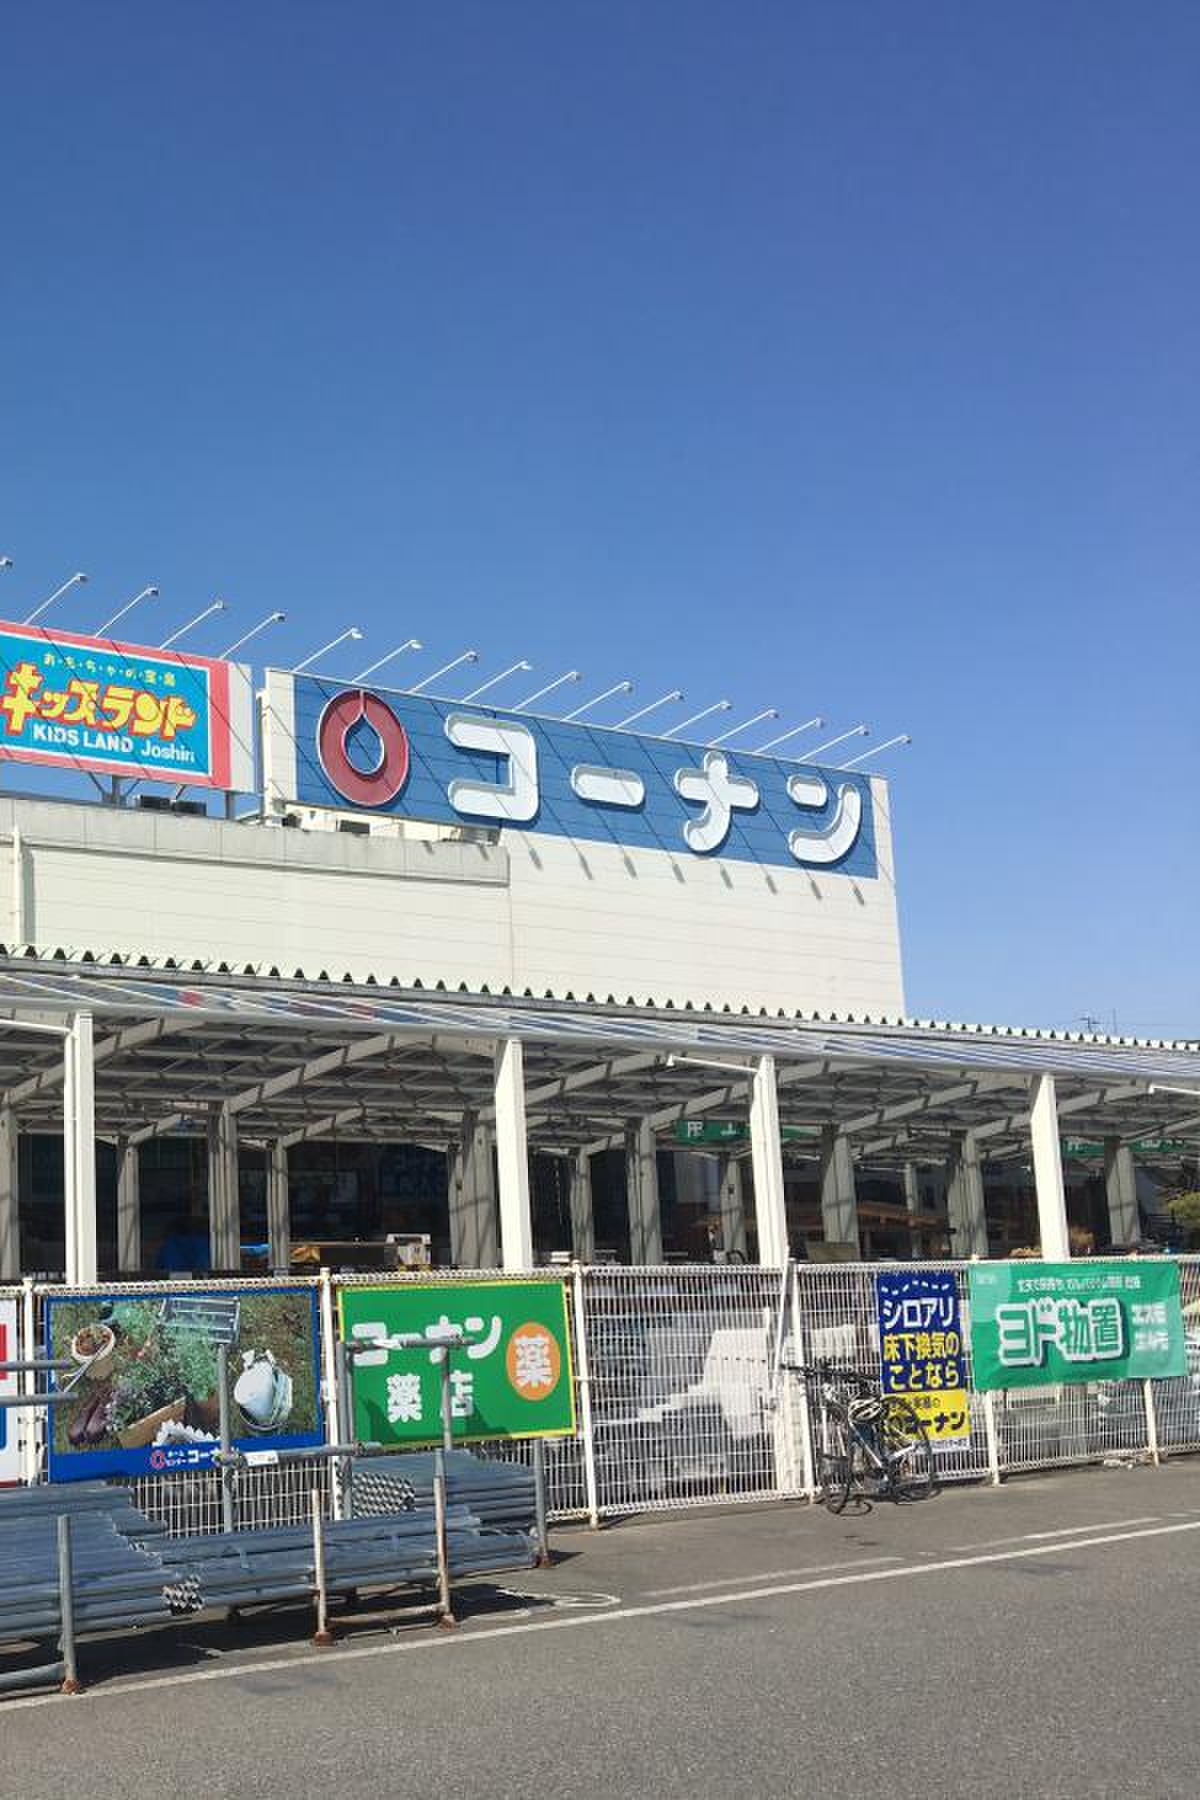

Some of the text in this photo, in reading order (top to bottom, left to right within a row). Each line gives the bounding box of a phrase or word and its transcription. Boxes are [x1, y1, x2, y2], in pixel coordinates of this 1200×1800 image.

[0, 662, 197, 739] キッズランド
[33, 724, 134, 754] KIDS LAND
[141, 740, 196, 764] Joshin
[444, 711, 863, 865] コーナン
[883, 1297, 954, 1329] シロアリ
[996, 1297, 1122, 1367] ヨド物置
[352, 1315, 502, 1367] コーナン
[514, 1334, 553, 1388] 薬
[883, 1332, 960, 1361] 床下換気の
[889, 1361, 960, 1391] ことなら
